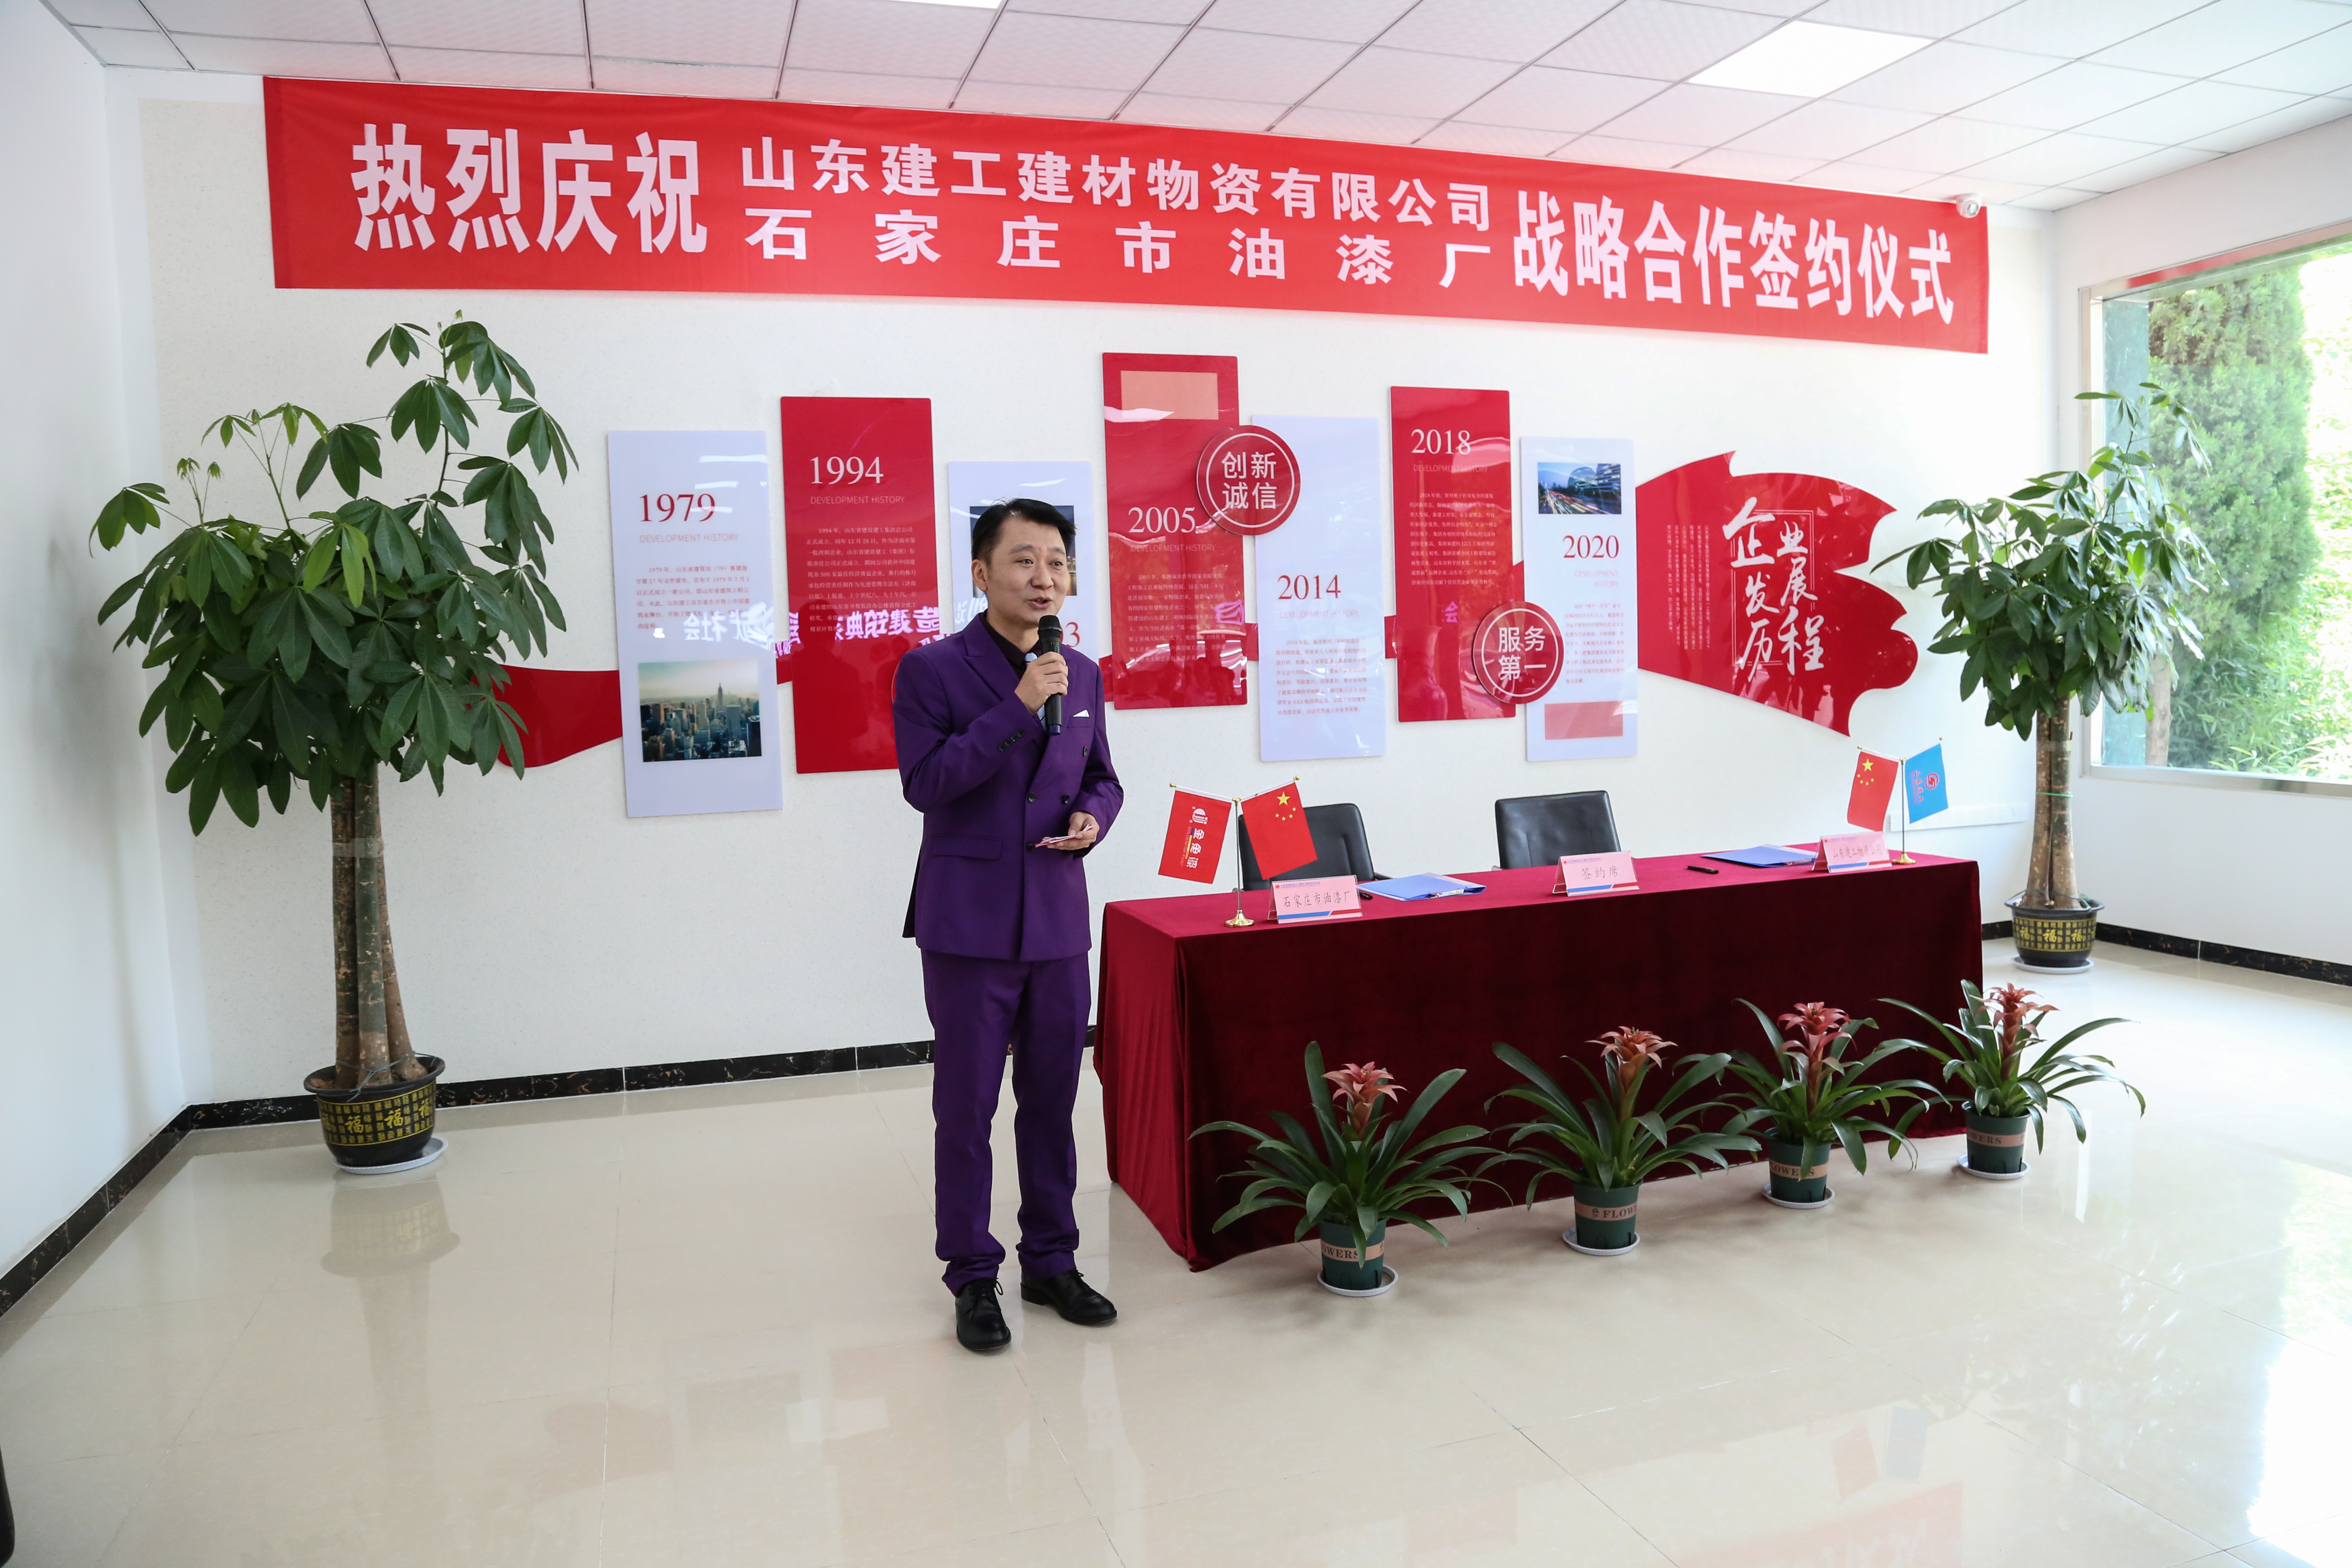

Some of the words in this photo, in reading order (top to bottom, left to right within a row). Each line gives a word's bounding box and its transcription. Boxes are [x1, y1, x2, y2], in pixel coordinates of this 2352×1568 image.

[351, 122, 707, 255] 热烈庆祝
[742, 136, 1490, 233] 山东建工建材物资有限公司
[745, 207, 1491, 288] 石家庄市油漆厂
[1514, 190, 1954, 325] 战略合作签约仪式
[1411, 429, 1471, 455] 2018
[810, 456, 884, 485] 1994
[1222, 451, 1277, 479] 创新
[639, 492, 716, 523] 1979
[811, 496, 869, 505] DEVELOPMENT
[871, 495, 904, 504] HISTORY
[1222, 482, 1277, 510] 诚信
[1128, 506, 1196, 534] 2005
[1722, 496, 1809, 568] 企业
[639, 534, 701, 543] DEVELOPMENT
[703, 533, 738, 542] HISTORY
[1131, 544, 1184, 552] DEVELOPMENT
[1185, 543, 1216, 552] HISTORY
[1563, 535, 1619, 559] 2020
[1277, 574, 1341, 600] 2014
[1746, 557, 1818, 617] 发展
[1498, 625, 1546, 653] 服务
[1738, 606, 1825, 682] 历程
[1499, 655, 1547, 681] 第一
[1581, 865, 1619, 880] 签约席
[1283, 891, 1350, 908] 石家庄市油漆厂
[345, 1115, 364, 1134] 福
[384, 1108, 404, 1129] 福
